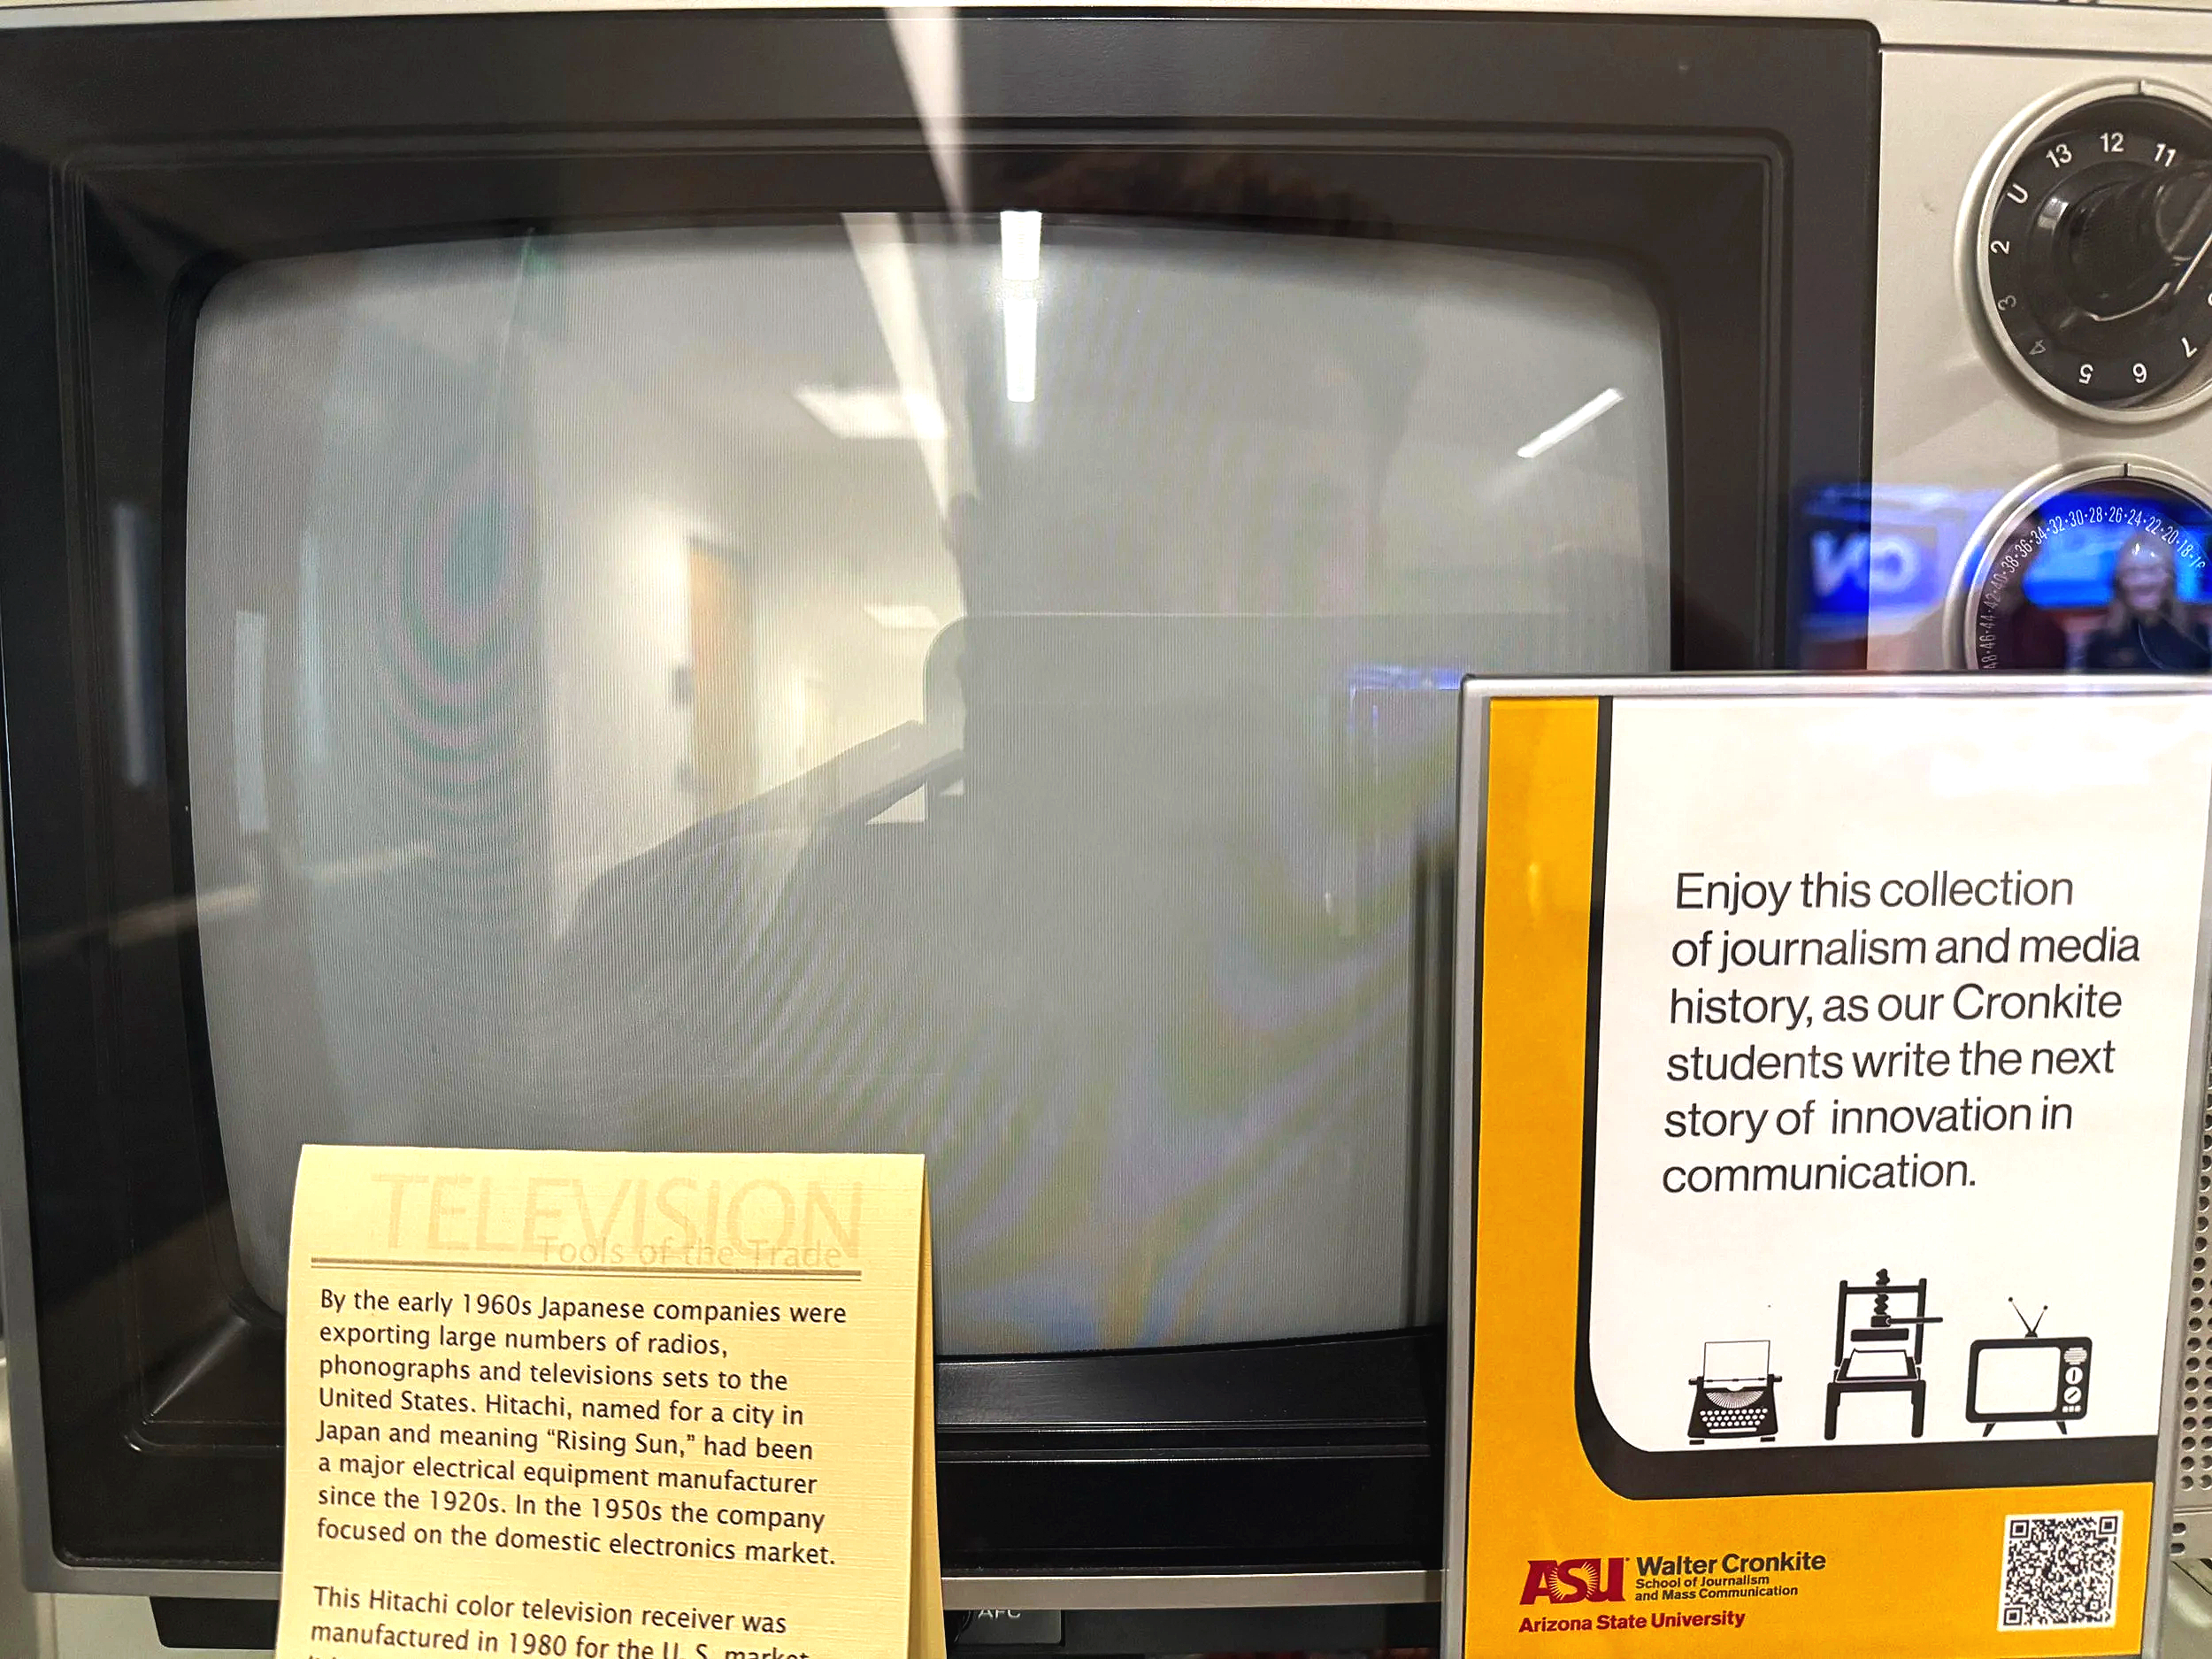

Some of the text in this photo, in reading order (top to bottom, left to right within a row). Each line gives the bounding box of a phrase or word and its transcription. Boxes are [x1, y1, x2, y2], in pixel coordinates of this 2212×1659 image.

[2046, 144, 2072, 167] 13
[2100, 133, 2124, 153] 12
[2154, 143, 2176, 167] 11
[2007, 183, 2028, 204] U
[1991, 241, 2010, 255] 2
[1998, 295, 2016, 311] 3
[2181, 337, 2197, 357] 7
[2078, 364, 2093, 384] 5
[2132, 363, 2147, 383] 6
[2001, 556, 2018, 572] 38
[2016, 540, 2032, 557] 36
[2031, 526, 2047, 544] 34
[2049, 516, 2065, 534] 32
[2069, 510, 2084, 526] 30
[2089, 506, 2102, 523] 28
[2108, 506, 2123, 523] 26
[2127, 510, 2142, 526] 24
[2146, 517, 2161, 534] 22
[2162, 526, 2178, 544] 20
[2177, 540, 2193, 557] 18
[1677, 871, 2072, 916] Enjoy this collection
[1672, 926, 2139, 973] of journalism and media
[1671, 984, 2121, 1030] history, as our Cronkite
[1667, 1041, 2116, 1081] students write the next
[1664, 1095, 2071, 1143] story of innovation in
[1663, 1154, 1975, 1193] communication.
[372, 1173, 864, 1258] TELEVISION
[538, 1235, 841, 1269] Tools of the Trade
[322, 1289, 846, 1325] By the early 1960s Japanese companies were
[320, 1325, 726, 1358] exporting large numbers of radios,
[320, 1356, 787, 1390] phonographs and televisions sets to the
[320, 1387, 803, 1428] United States. Hitachi, named for a city in
[316, 1420, 811, 1459] Japan and meaning “Rising Sun,” had been
[319, 1455, 818, 1494] a major electrical equipment manufacturer
[319, 1486, 825, 1533] since the 1920s. In the 1950s the company
[318, 1517, 834, 1564] focused on the domestic electronics market.
[1519, 1557, 1628, 1605] ASU
[1636, 1551, 1826, 1576] Walter Cronkite
[1635, 1574, 1770, 1589] School of Journalism
[1635, 1586, 1798, 1601] and Mass Communication
[314, 1586, 786, 1633] This Hitachi color television receiver was
[1518, 1609, 1746, 1633] Arizona State University
[311, 1624, 468, 1649] manufactured
[479, 1632, 497, 1652] in
[511, 1633, 566, 1655] 1980
[577, 1636, 609, 1658] for
[618, 1639, 653, 1659] the
[664, 1641, 685, 1659] U
